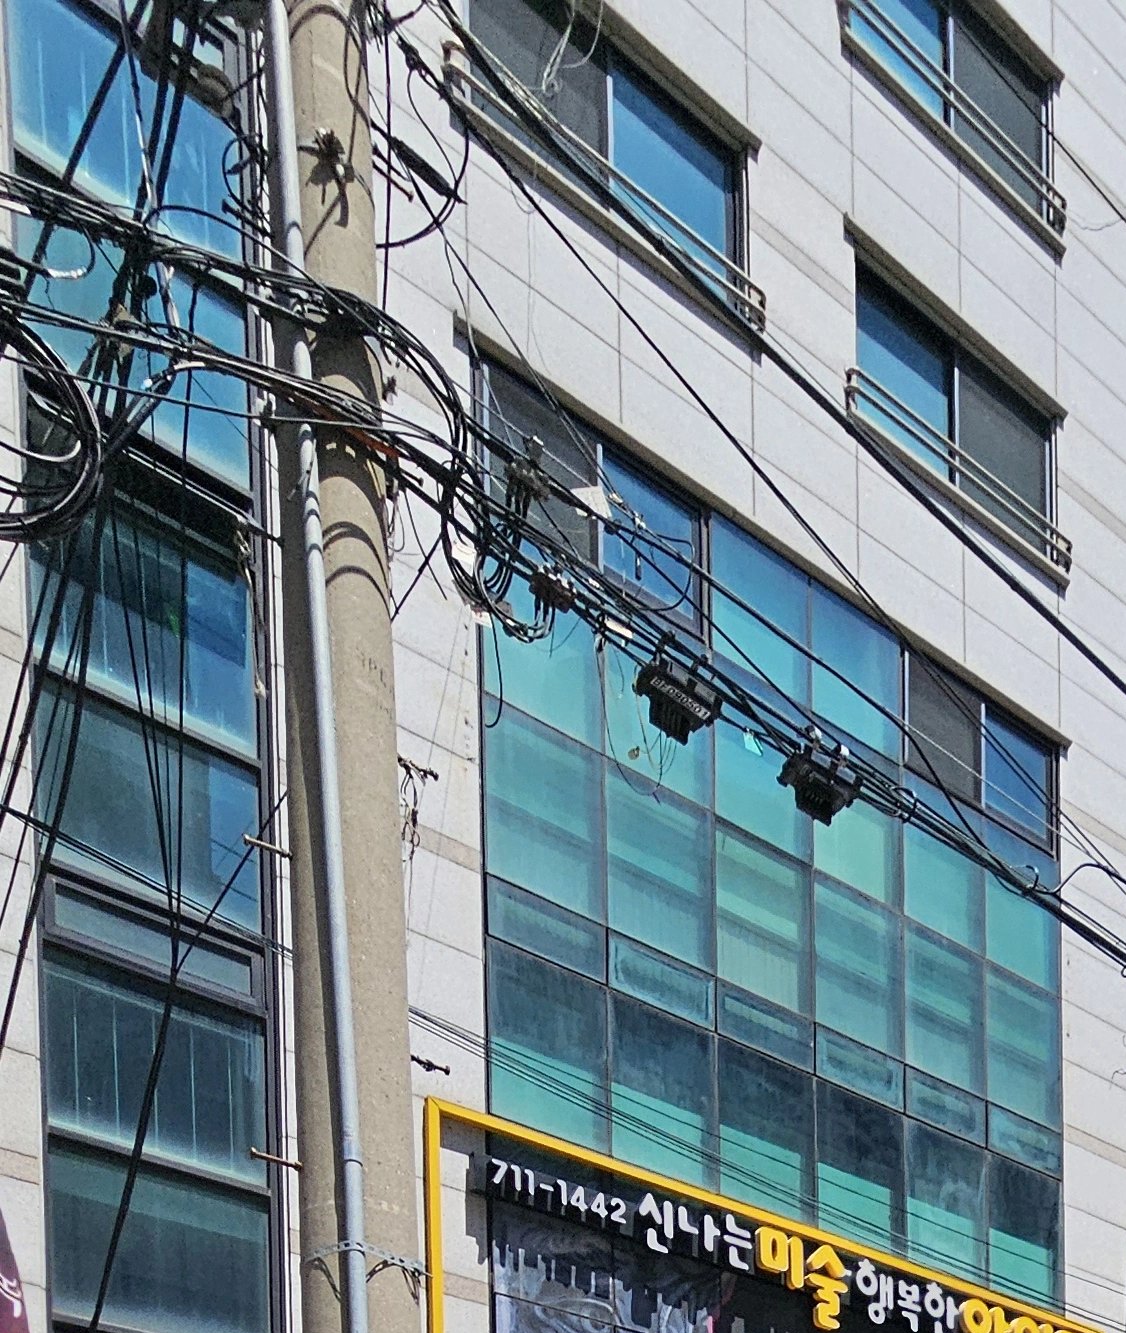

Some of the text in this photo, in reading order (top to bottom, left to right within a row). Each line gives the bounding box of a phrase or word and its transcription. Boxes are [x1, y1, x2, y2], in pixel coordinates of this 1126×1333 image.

[491, 1158, 626, 1224] 711-1442
[639, 1193, 752, 1270] 신나는
[756, 1226, 848, 1330] 미술
